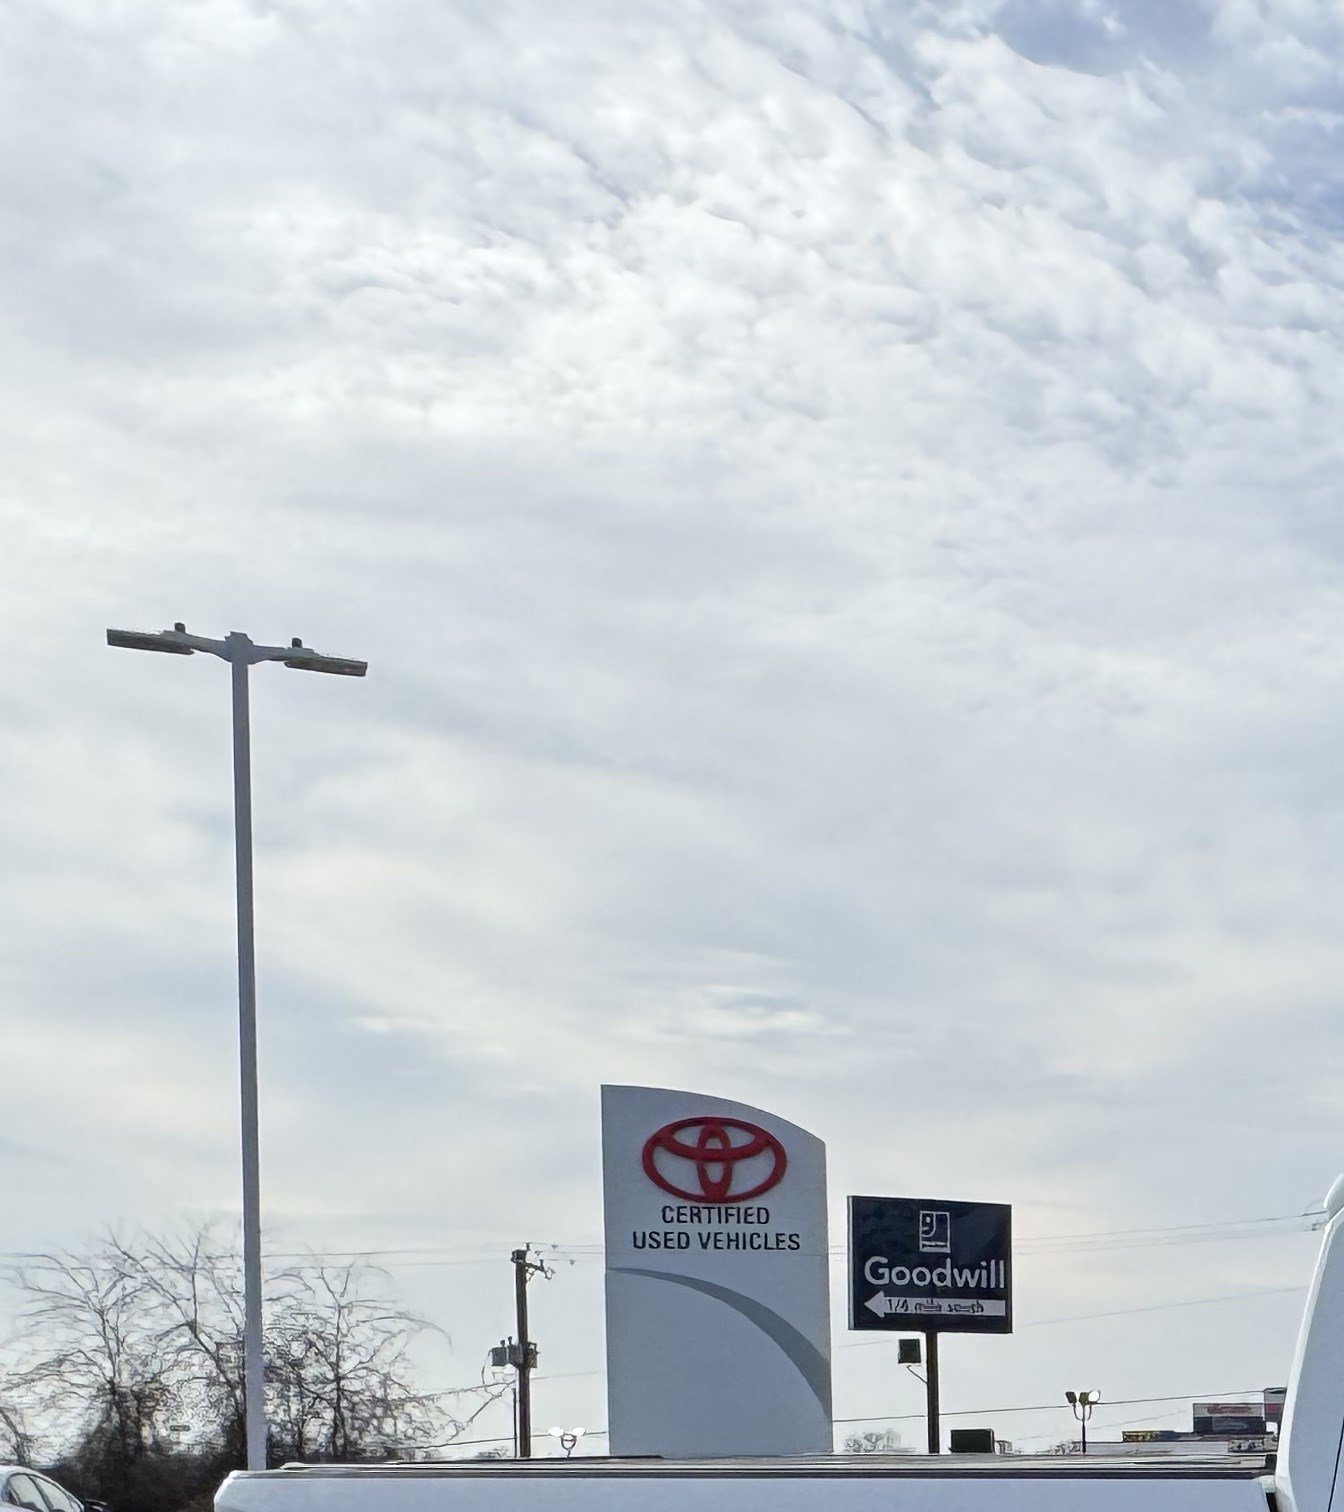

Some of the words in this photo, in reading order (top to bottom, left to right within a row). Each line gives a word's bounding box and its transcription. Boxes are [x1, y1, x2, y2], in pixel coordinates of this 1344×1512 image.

[661, 1205, 770, 1225] CERTIFIED
[632, 1231, 690, 1250] USED
[698, 1232, 800, 1251] VEHICLES
[864, 1256, 1004, 1289] Goodwill
